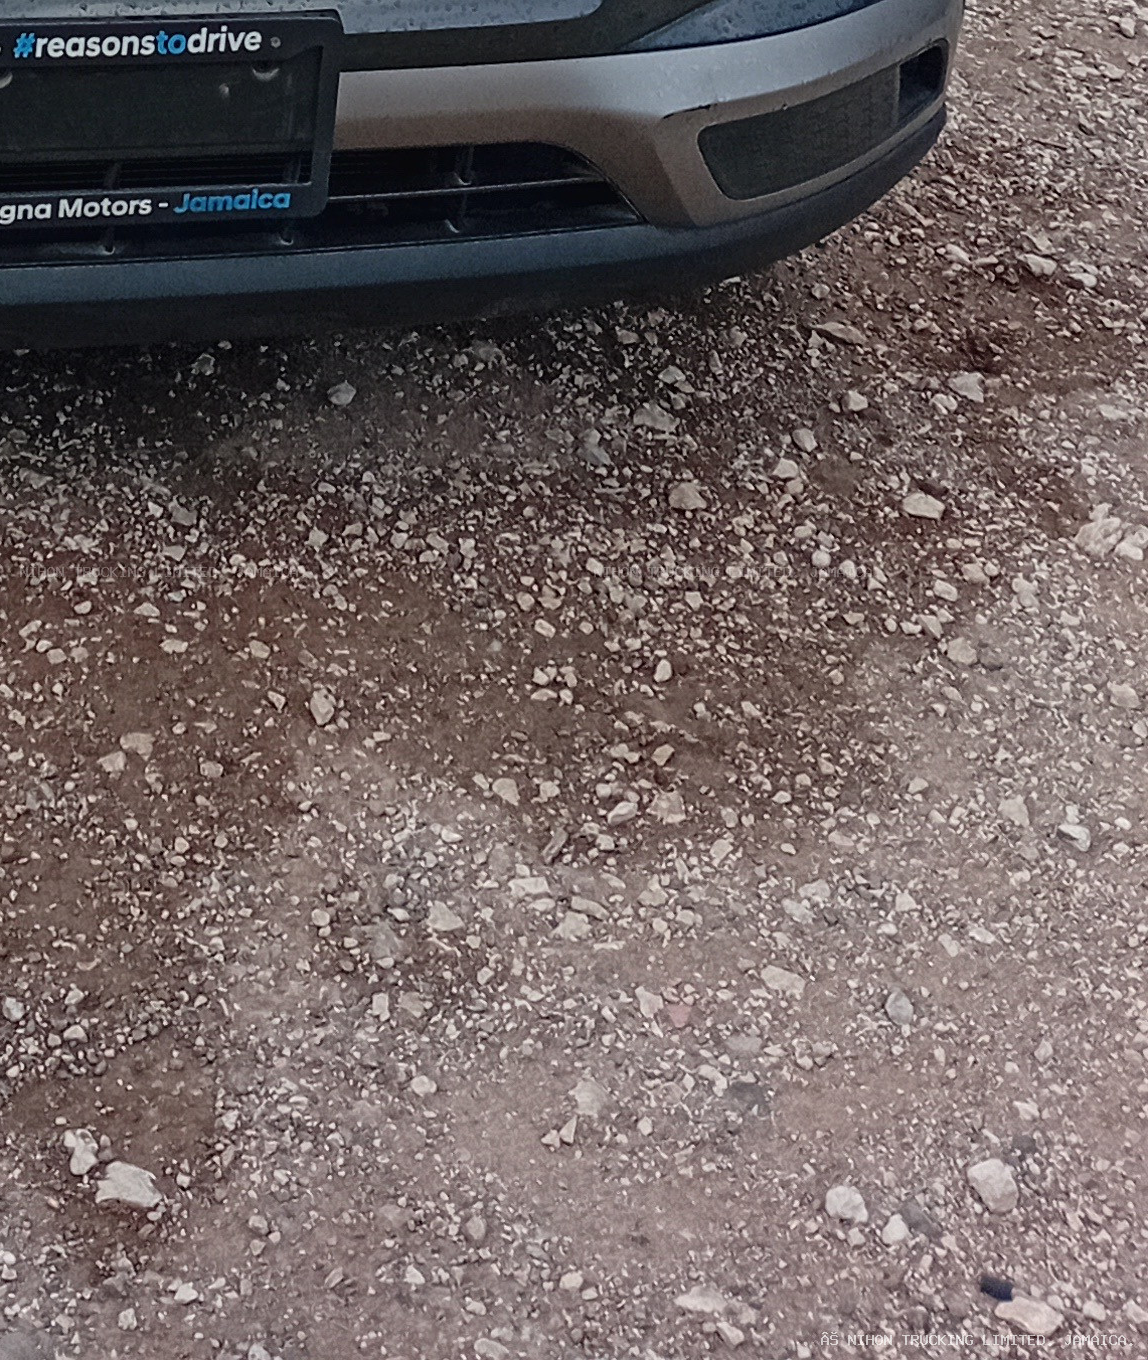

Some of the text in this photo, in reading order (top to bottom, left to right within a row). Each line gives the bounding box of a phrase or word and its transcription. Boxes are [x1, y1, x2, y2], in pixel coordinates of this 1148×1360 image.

[12, 26, 263, 59] #reasonstodrive
[57, 197, 153, 219] Motors
[173, 188, 292, 214] Jamaica
